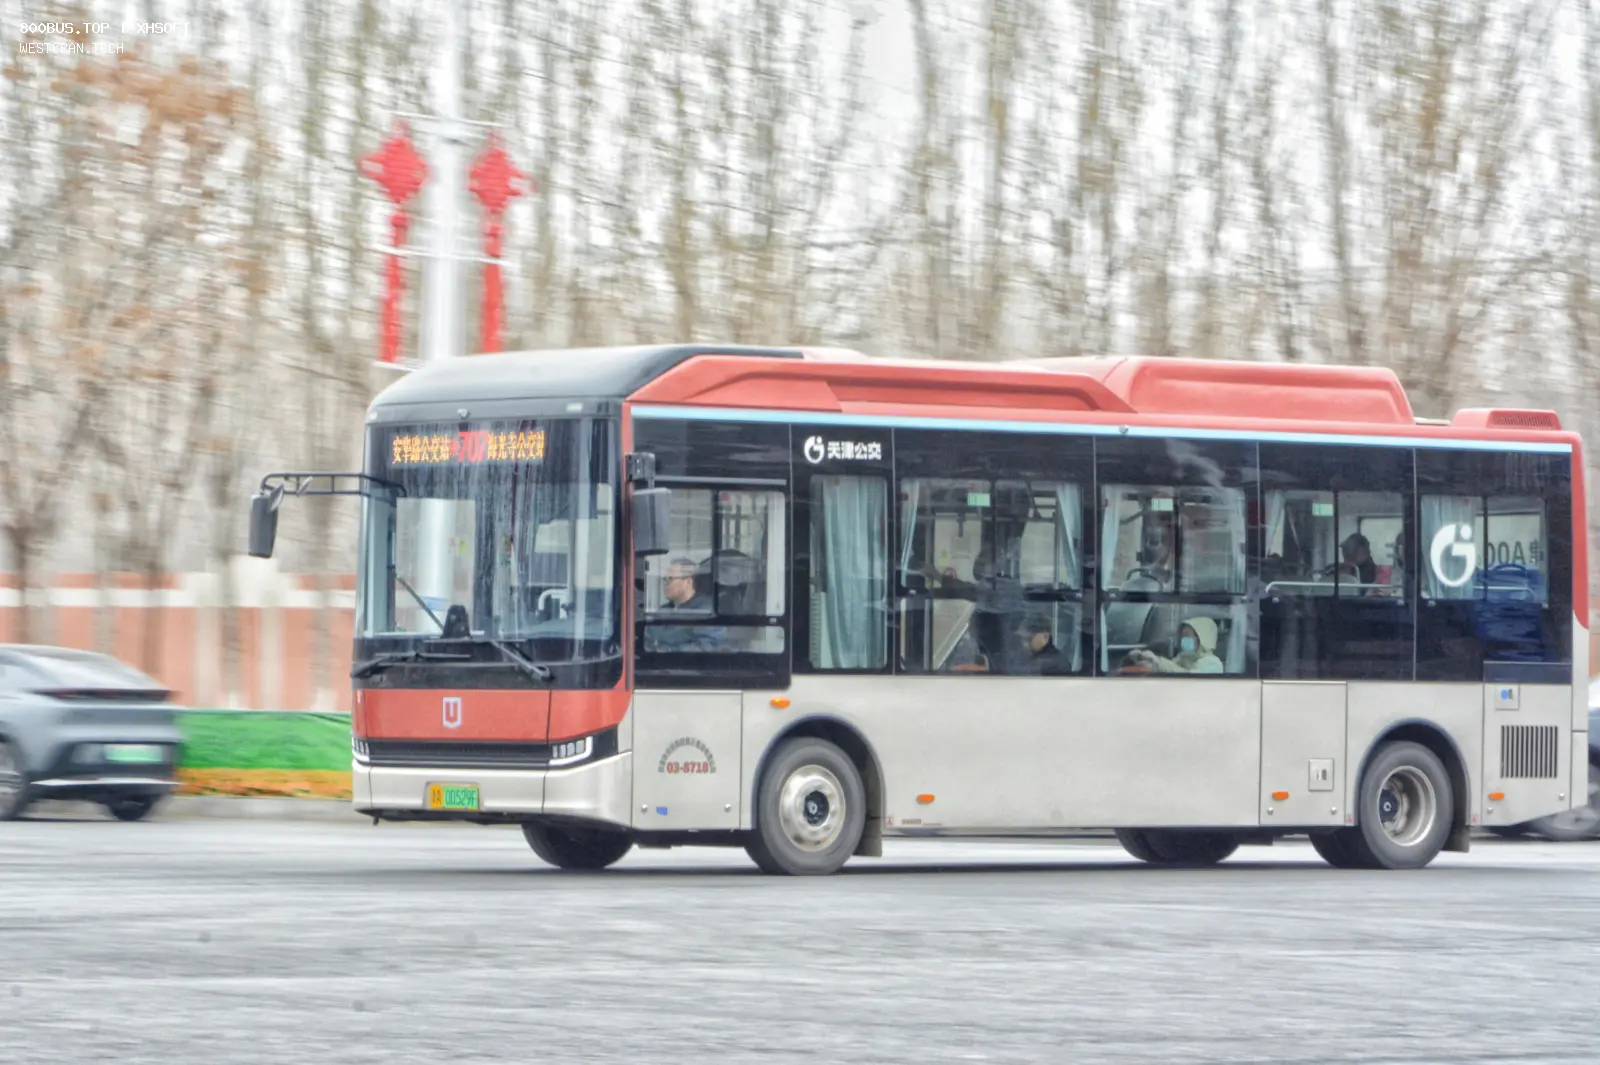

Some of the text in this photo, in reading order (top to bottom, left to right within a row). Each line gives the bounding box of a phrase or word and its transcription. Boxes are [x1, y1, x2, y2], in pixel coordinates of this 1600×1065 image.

[458, 430, 489, 463] 707
[828, 441, 882, 461] 天津公交
[667, 761, 709, 774] 03-8718
